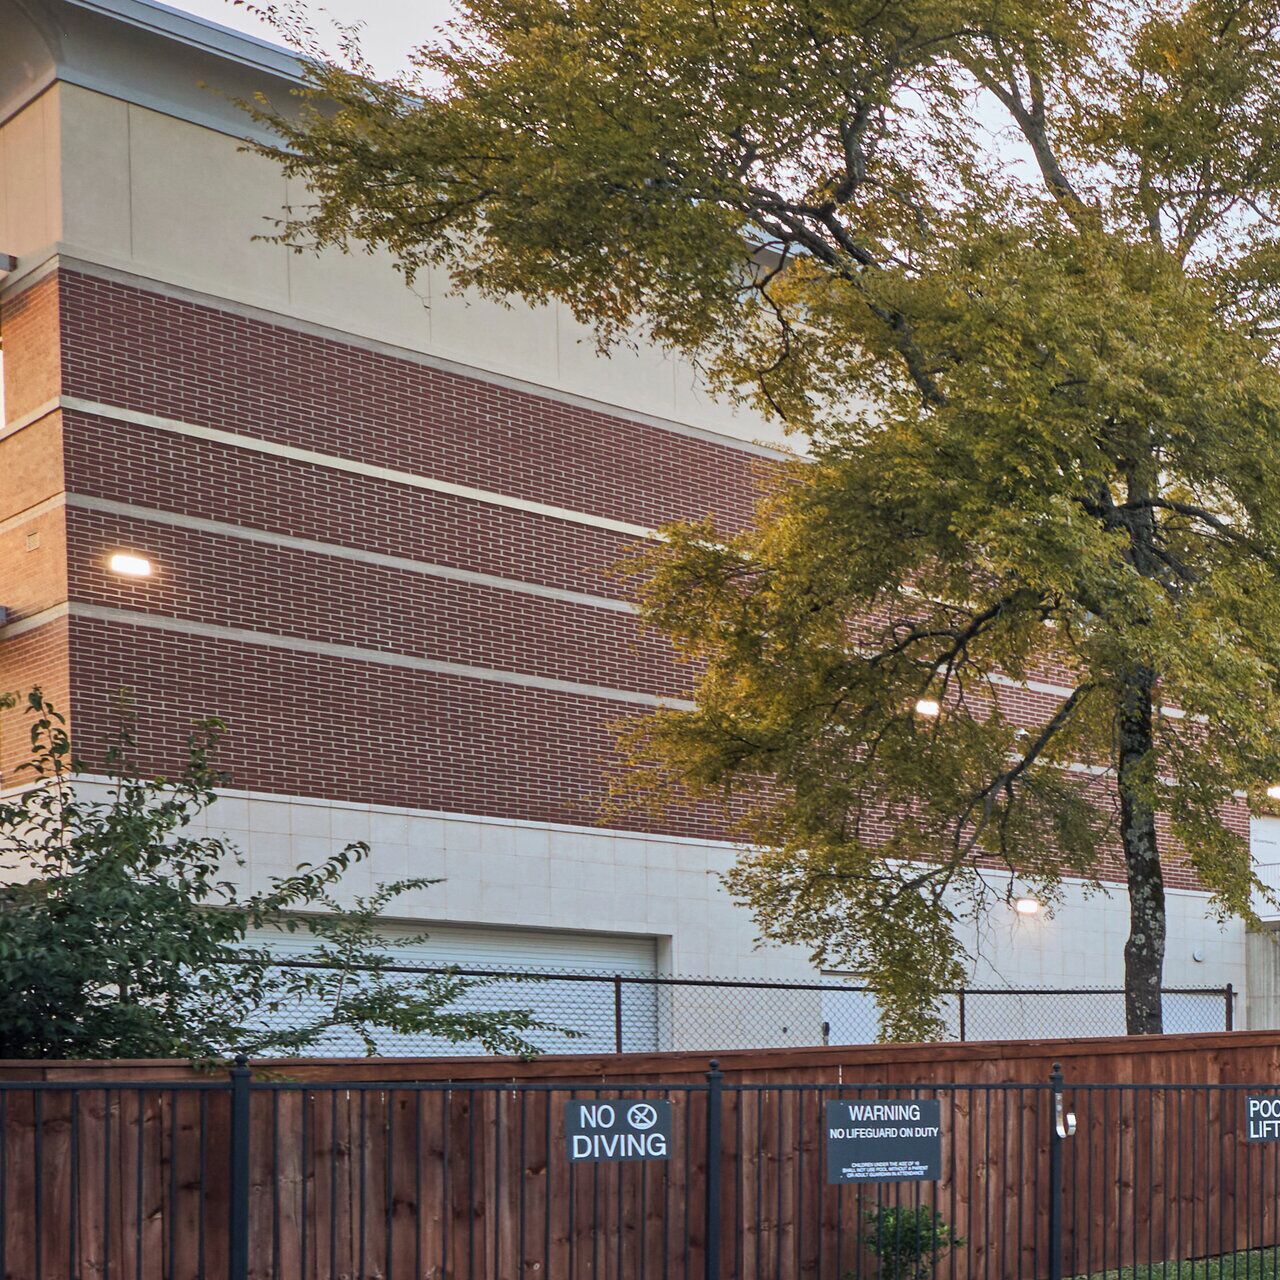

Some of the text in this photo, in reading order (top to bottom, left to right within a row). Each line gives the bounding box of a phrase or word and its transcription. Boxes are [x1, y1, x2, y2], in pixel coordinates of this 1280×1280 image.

[580, 1104, 615, 1129] NO
[848, 1104, 920, 1121] WARNING
[830, 1127, 939, 1139] NO LIFEGUARD ON DUTY
[1250, 1120, 1280, 1138] LIFT
[572, 1132, 667, 1158] DIVING
